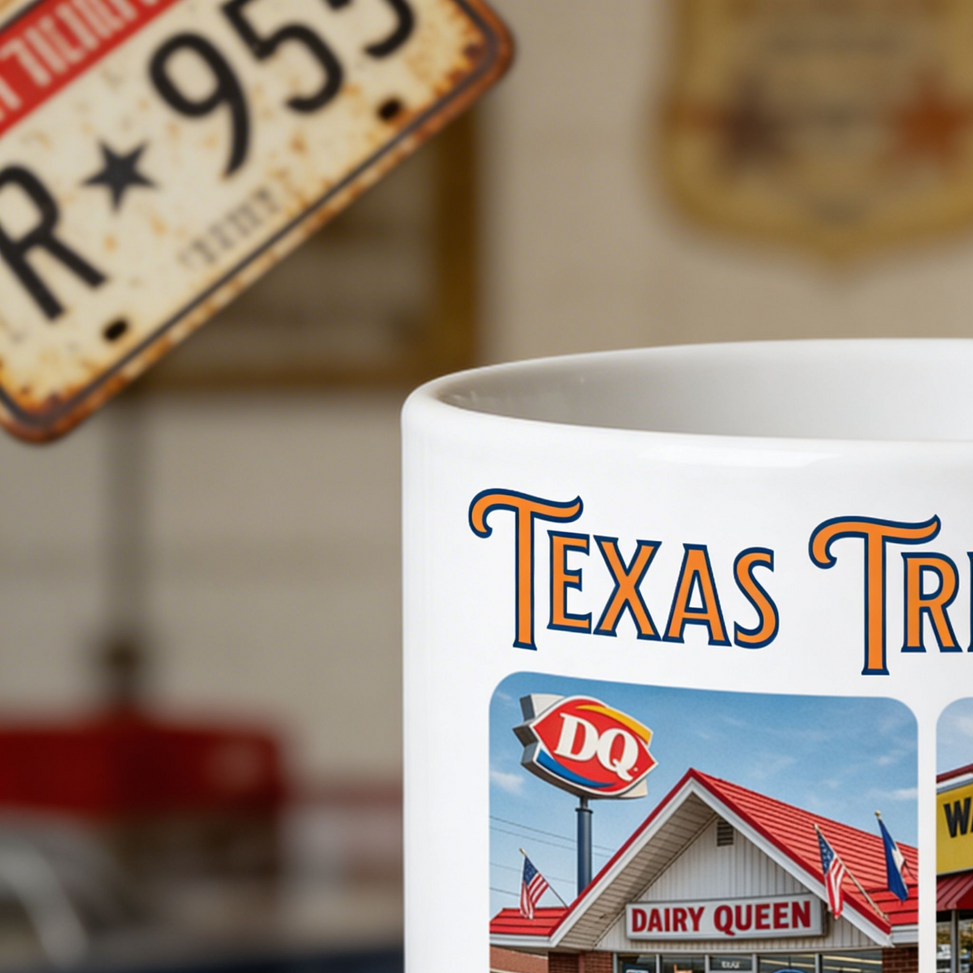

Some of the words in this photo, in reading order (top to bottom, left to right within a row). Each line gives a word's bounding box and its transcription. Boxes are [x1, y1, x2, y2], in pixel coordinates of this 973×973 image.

[468, 488, 780, 651] TEXAS
[553, 712, 639, 782] DQ
[631, 906, 705, 932] DAIRY
[713, 900, 811, 936] QUEEN
